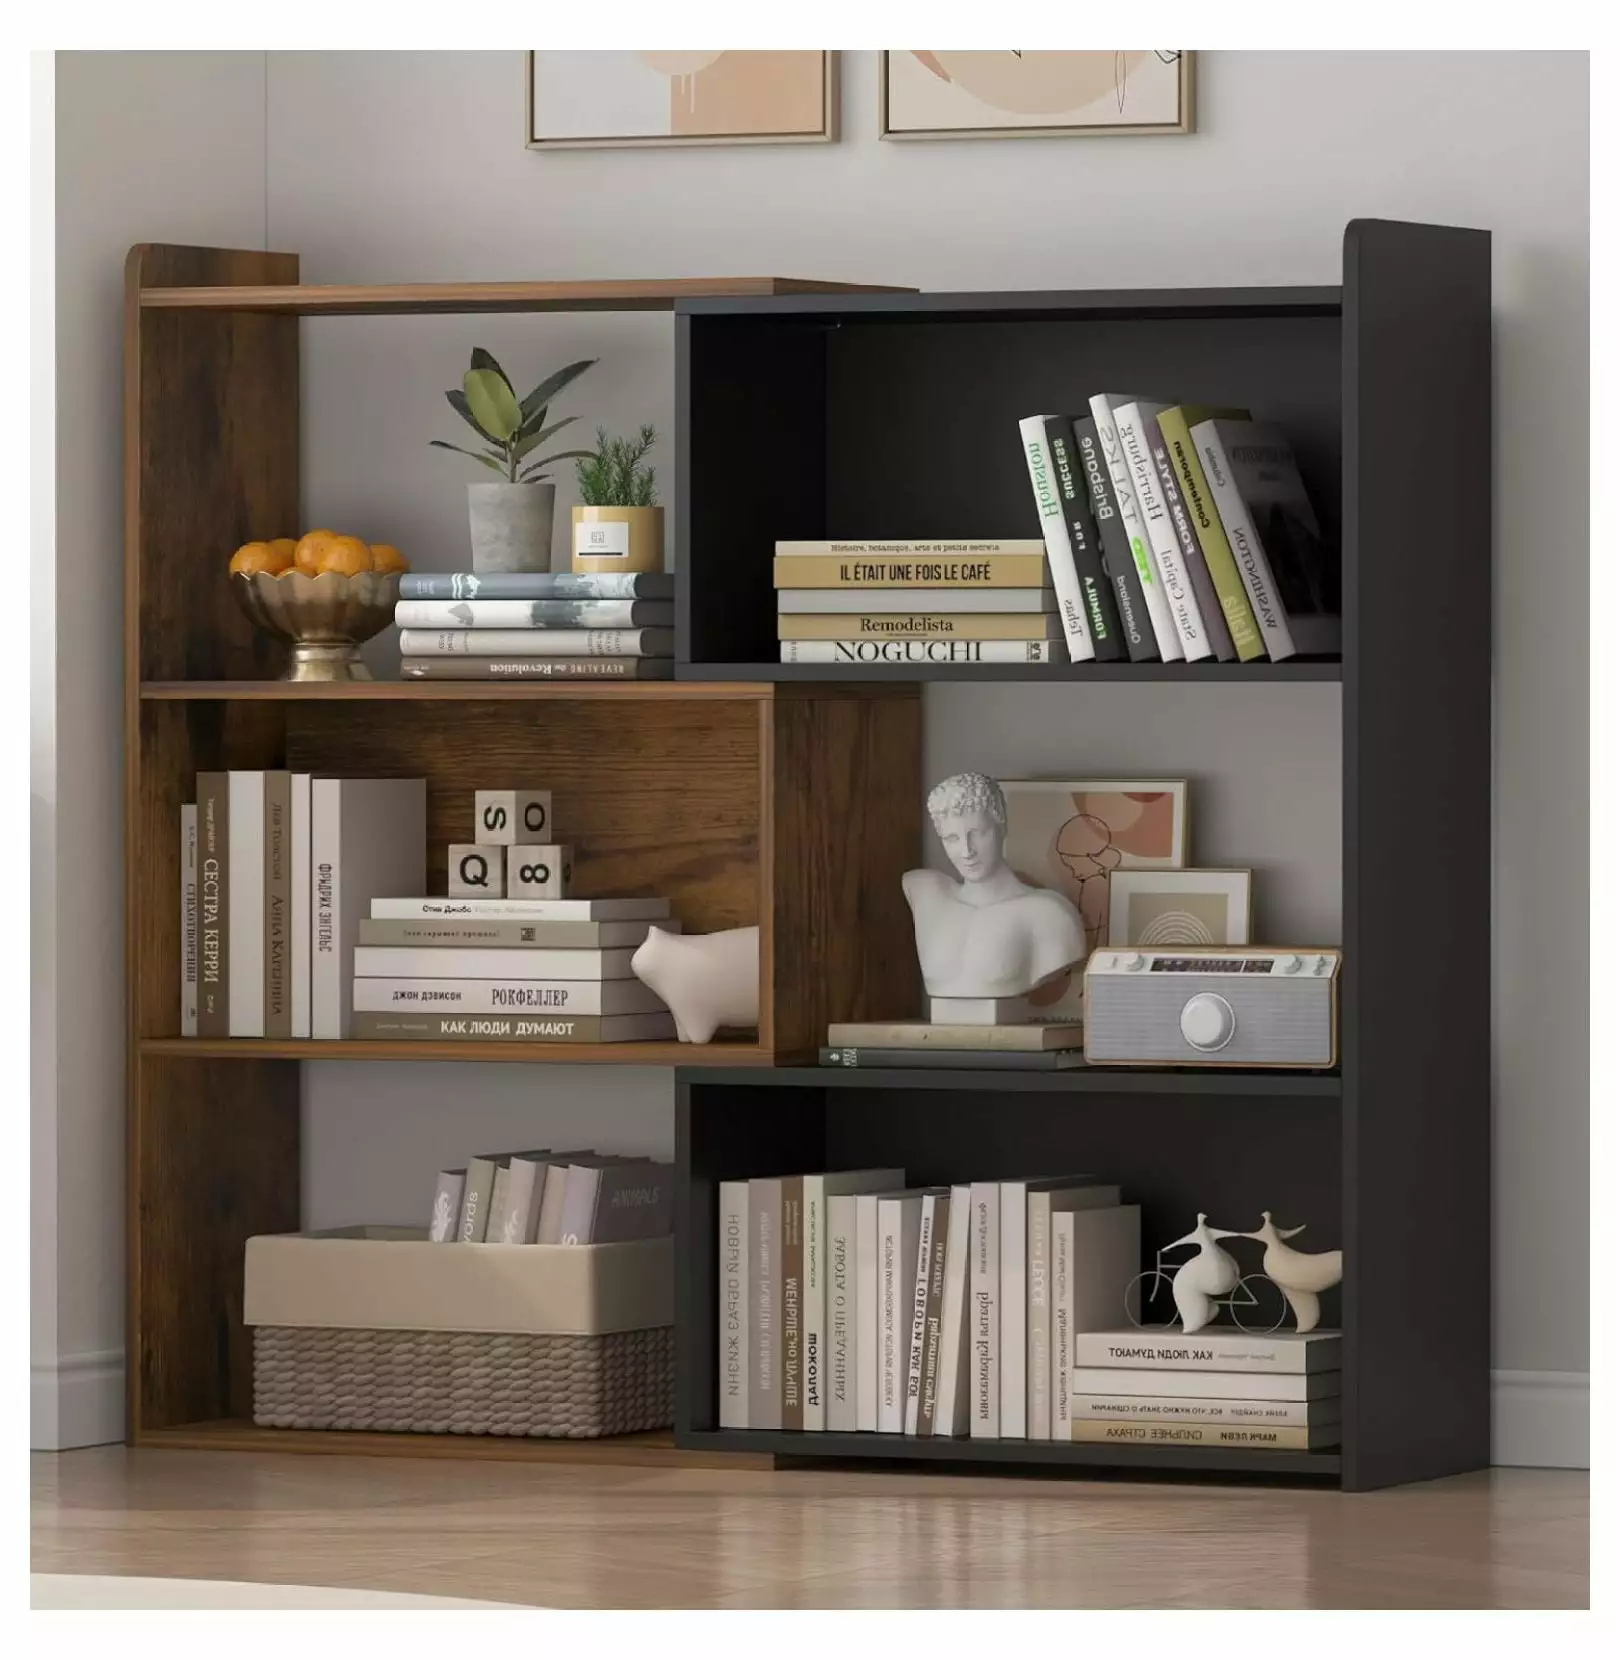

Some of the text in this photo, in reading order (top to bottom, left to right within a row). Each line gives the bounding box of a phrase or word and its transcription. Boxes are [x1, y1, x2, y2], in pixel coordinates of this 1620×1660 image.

[840, 561, 991, 581] IL ÉTAIT UNE FOIS LE CAFÉ
[860, 617, 953, 632] Remodelista
[834, 641, 983, 661] NOGUCHI
[489, 663, 551, 675] Revolution
[484, 806, 506, 831] S
[460, 854, 488, 887] Q
[520, 864, 549, 884] 8
[203, 858, 219, 924] СЕСТРА
[318, 863, 333, 952] ФРИДРИХ ЭНГЕЛЬС
[203, 928, 219, 982] КЕРРИ
[392, 991, 462, 1002] ДЖОН ДЭВИСОН
[492, 988, 568, 1006] РОКФЕЛЛЕР
[440, 1021, 466, 1034] КАК
[469, 1021, 510, 1035] ЛЮДИ
[516, 1022, 574, 1036] ДУМАЮТ
